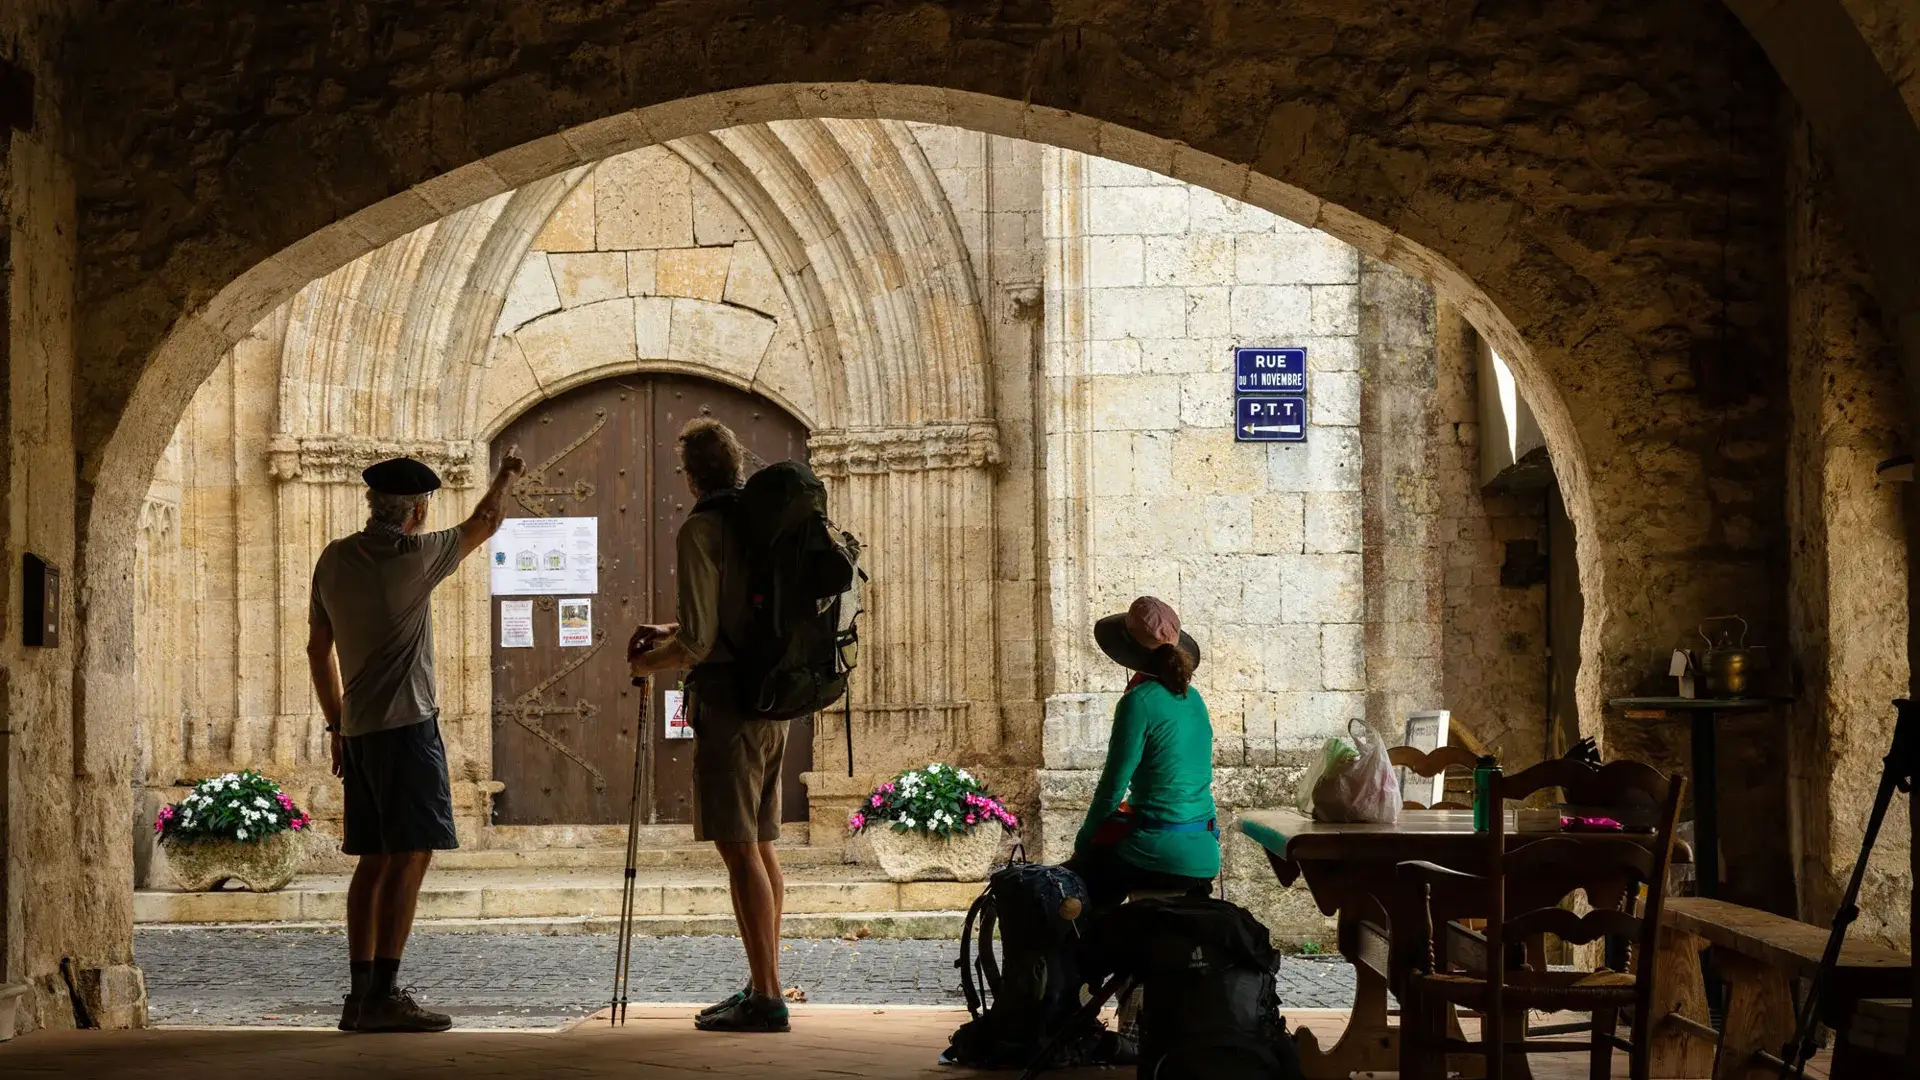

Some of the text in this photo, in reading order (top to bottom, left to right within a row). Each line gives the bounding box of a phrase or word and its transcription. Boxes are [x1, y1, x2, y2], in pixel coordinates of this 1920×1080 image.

[1255, 355, 1287, 368] RUE
[1239, 373, 1302, 386] DU 11 NOVEMBRE
